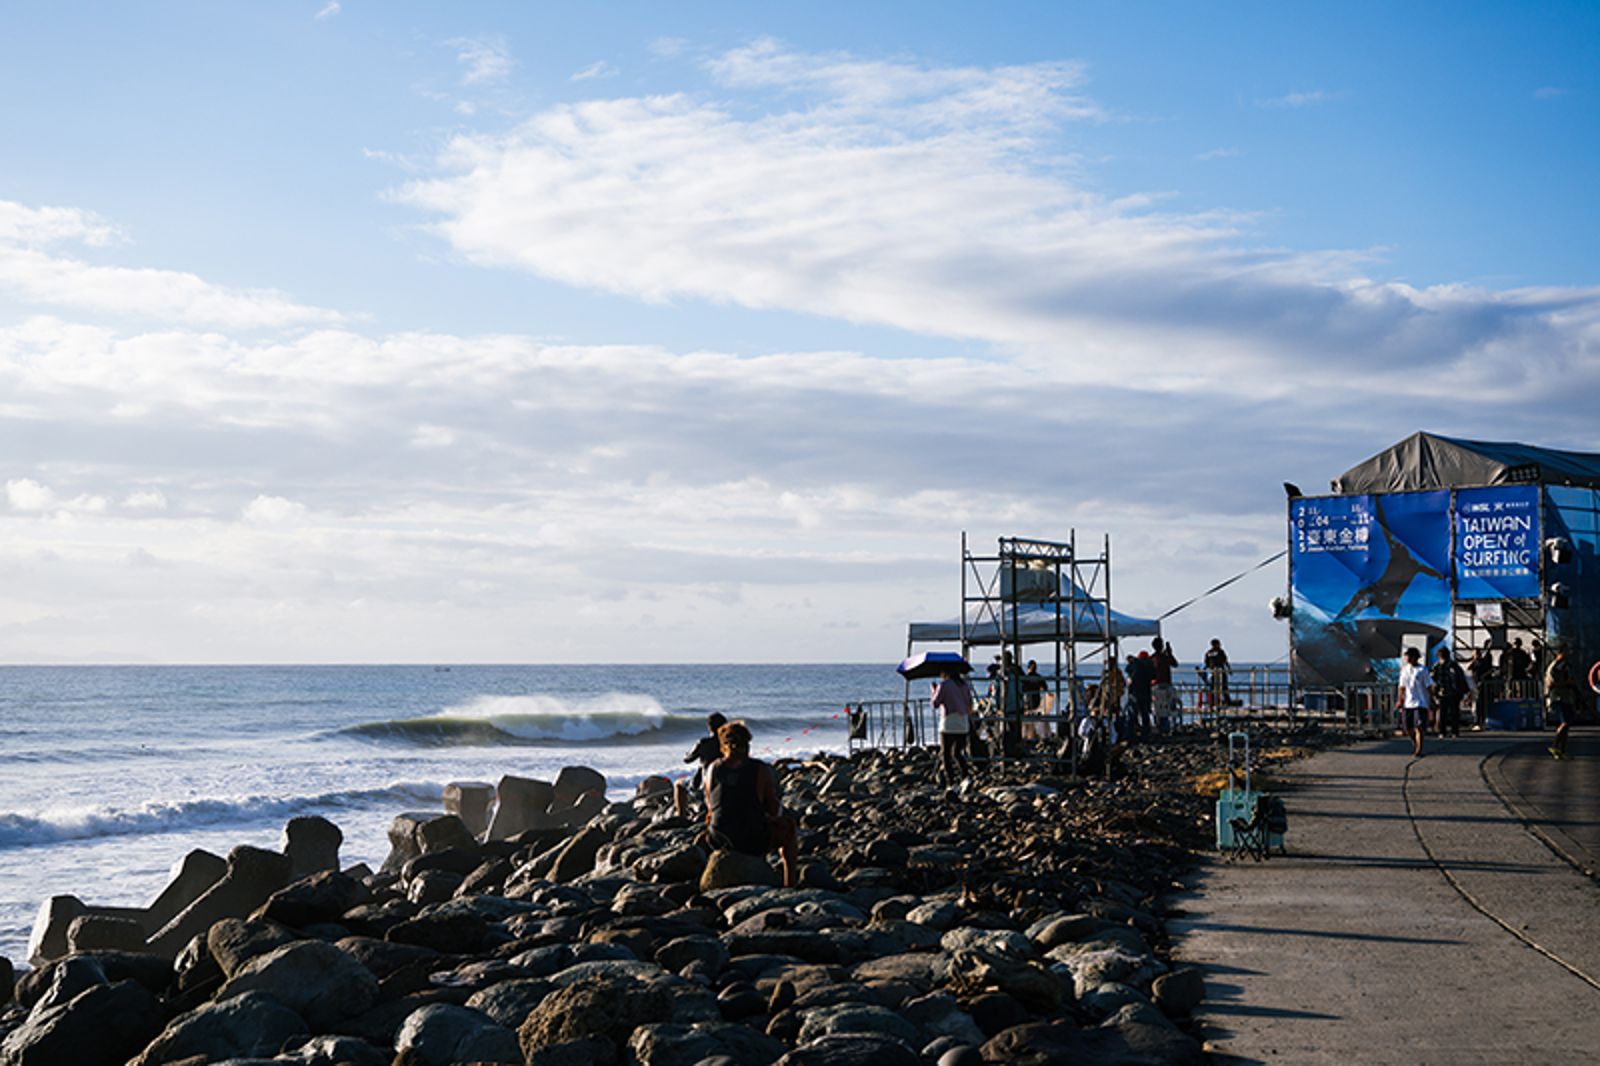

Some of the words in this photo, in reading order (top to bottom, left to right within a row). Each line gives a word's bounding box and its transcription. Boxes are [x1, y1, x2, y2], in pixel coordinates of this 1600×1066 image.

[1298, 506, 1306, 553] 2025
[1462, 515, 1531, 533] TAIWAN
[1463, 533, 1511, 550] OPEN
[1513, 532, 1526, 548] of
[1463, 549, 1531, 567] SURFING
